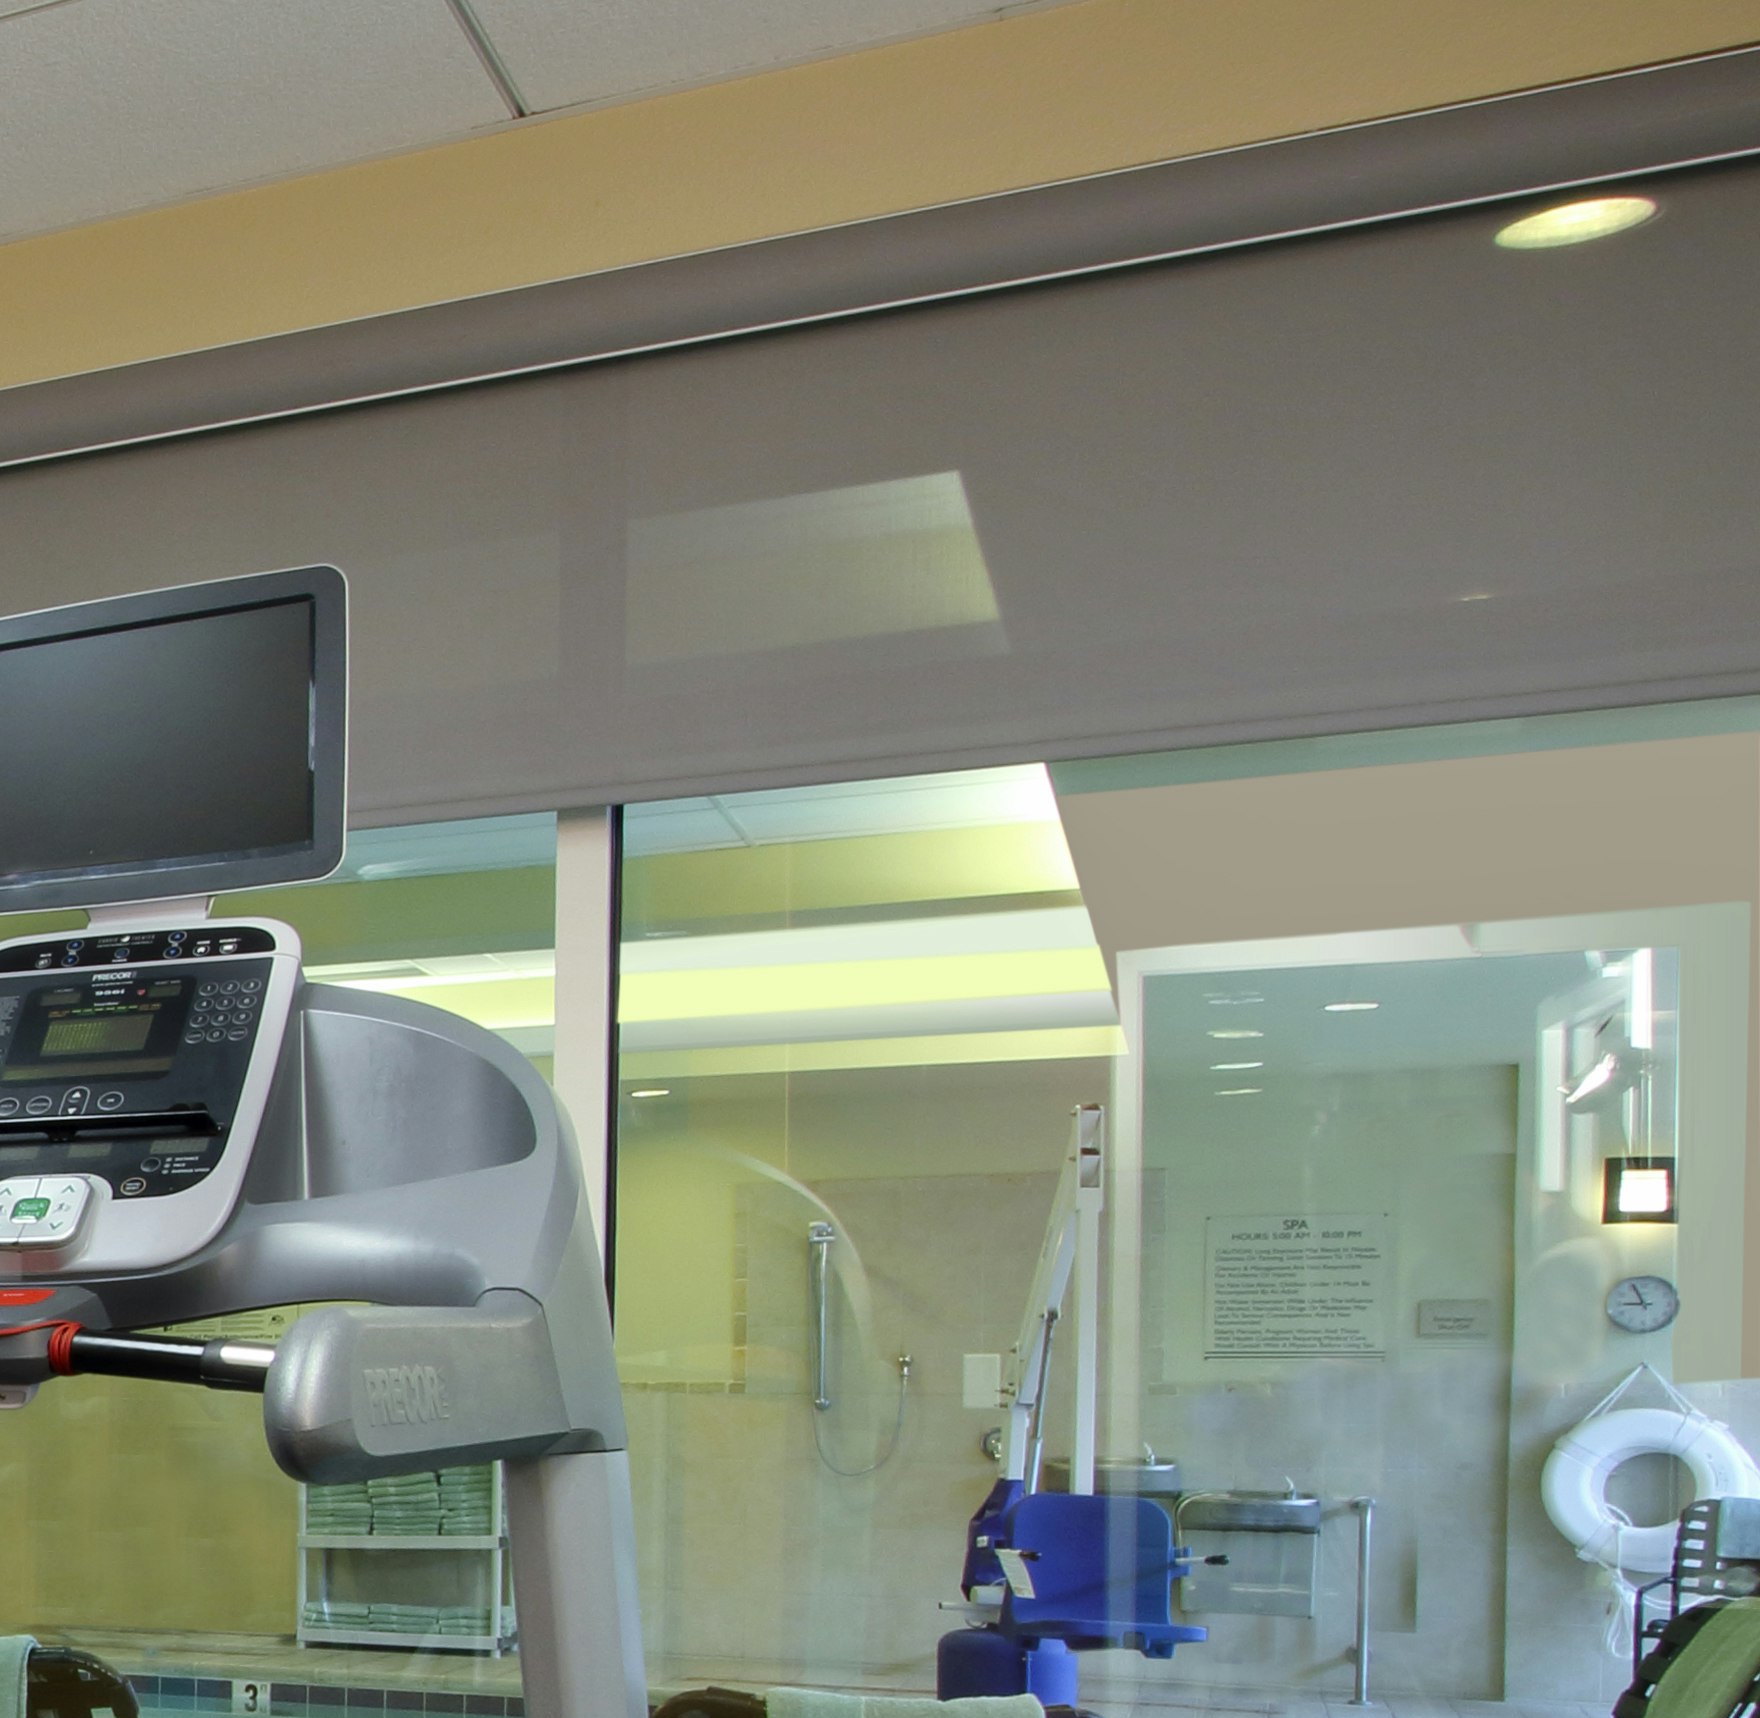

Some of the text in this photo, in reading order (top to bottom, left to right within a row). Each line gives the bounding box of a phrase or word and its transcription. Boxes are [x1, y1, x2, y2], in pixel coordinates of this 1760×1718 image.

[92, 972, 132, 982] PRECOR
[1283, 1219, 1308, 1230] SPA
[1231, 1233, 1269, 1241] HOURS
[1347, 1231, 1362, 1239] PM
[362, 1365, 438, 1428] PRECOR
[243, 1683, 258, 1713] 3
